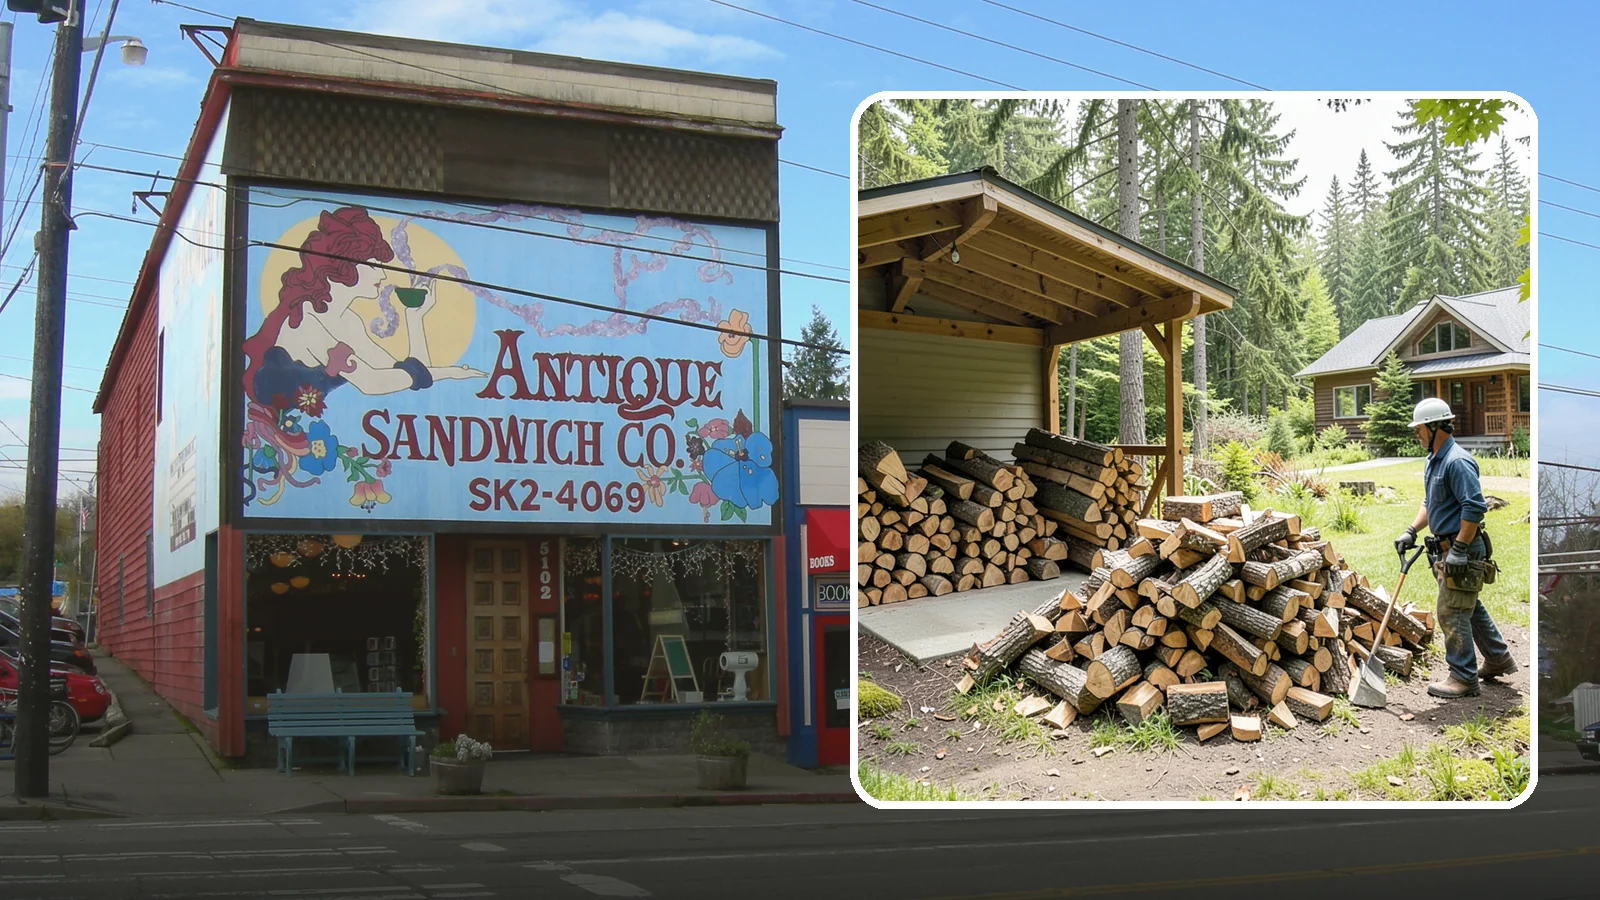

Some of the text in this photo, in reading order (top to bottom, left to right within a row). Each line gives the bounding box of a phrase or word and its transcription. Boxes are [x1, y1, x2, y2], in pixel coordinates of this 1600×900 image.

[475, 329, 723, 421] ANTIQUE
[361, 408, 685, 469] SANDWICH CO.
[468, 476, 646, 513] SK2-4069
[539, 542, 551, 599] 5102
[809, 555, 835, 569] BOOKS
